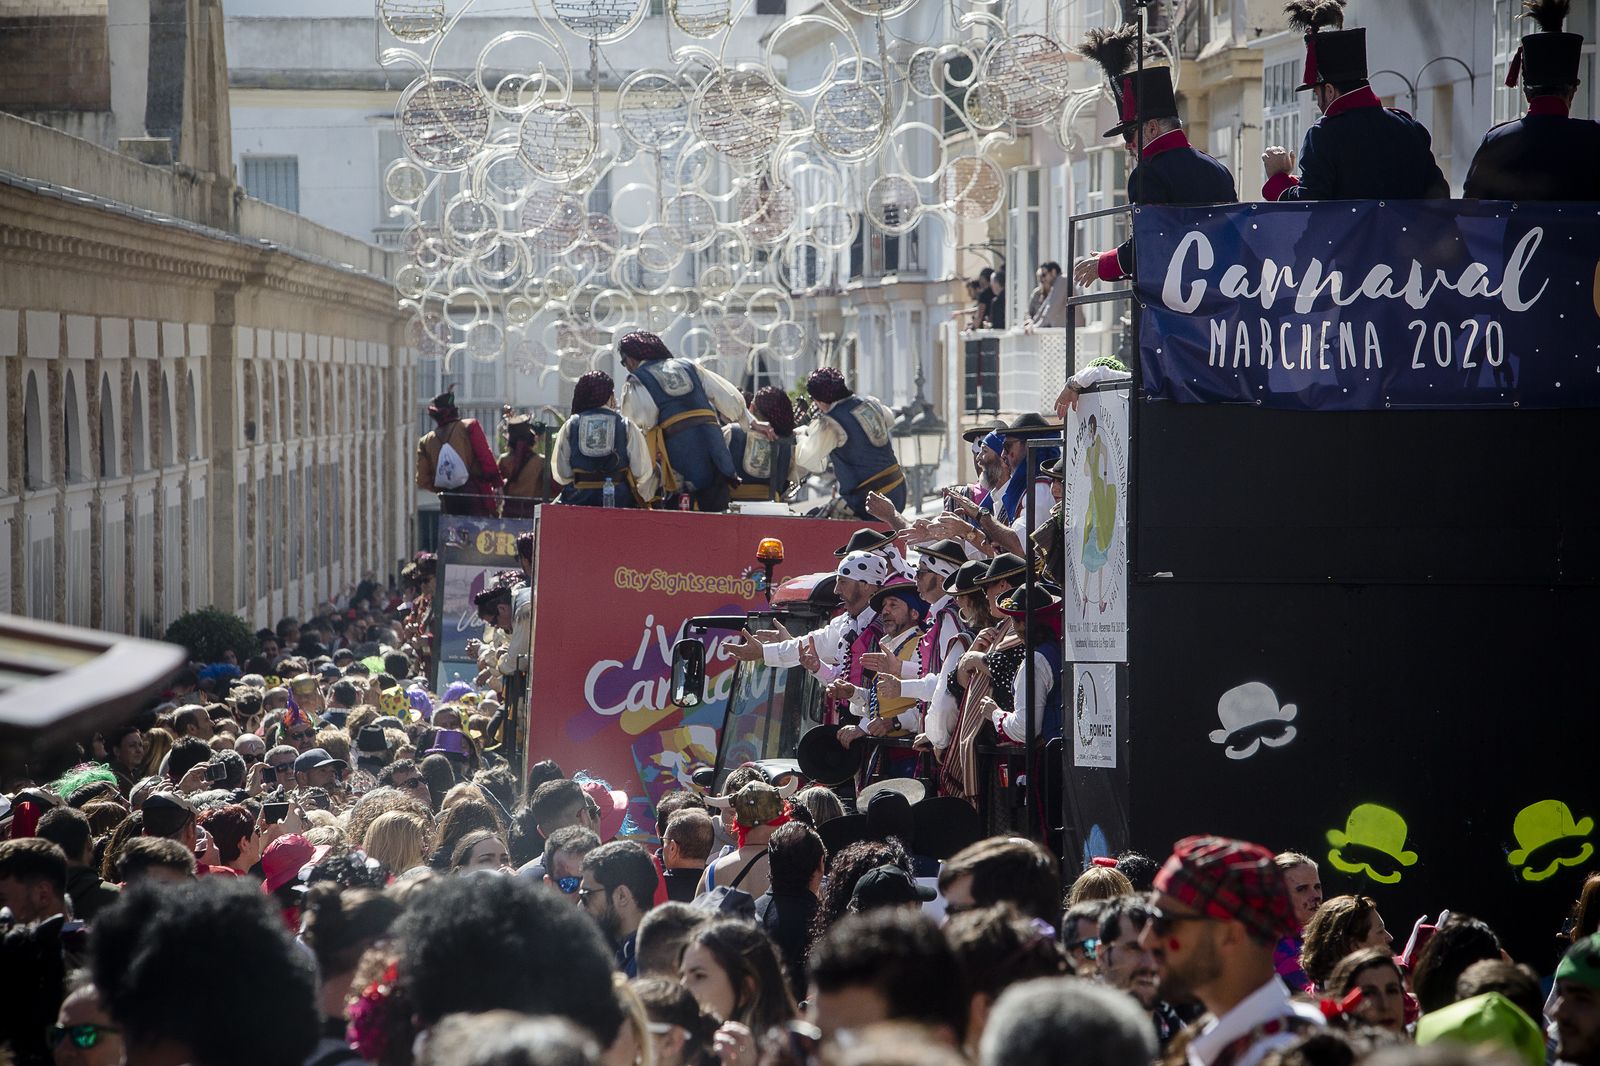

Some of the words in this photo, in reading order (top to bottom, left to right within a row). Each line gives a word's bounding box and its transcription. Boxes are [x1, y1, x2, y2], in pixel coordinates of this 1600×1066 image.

[1162, 226, 1549, 314] Carnaval
[1209, 318, 1383, 370] MARCHENA
[1408, 319, 1504, 370] 2020
[1076, 417, 1088, 449] PEPA
[476, 530, 519, 557] CR
[632, 614, 742, 671] ¡Vva
[1090, 723, 1112, 737] ROMATE
